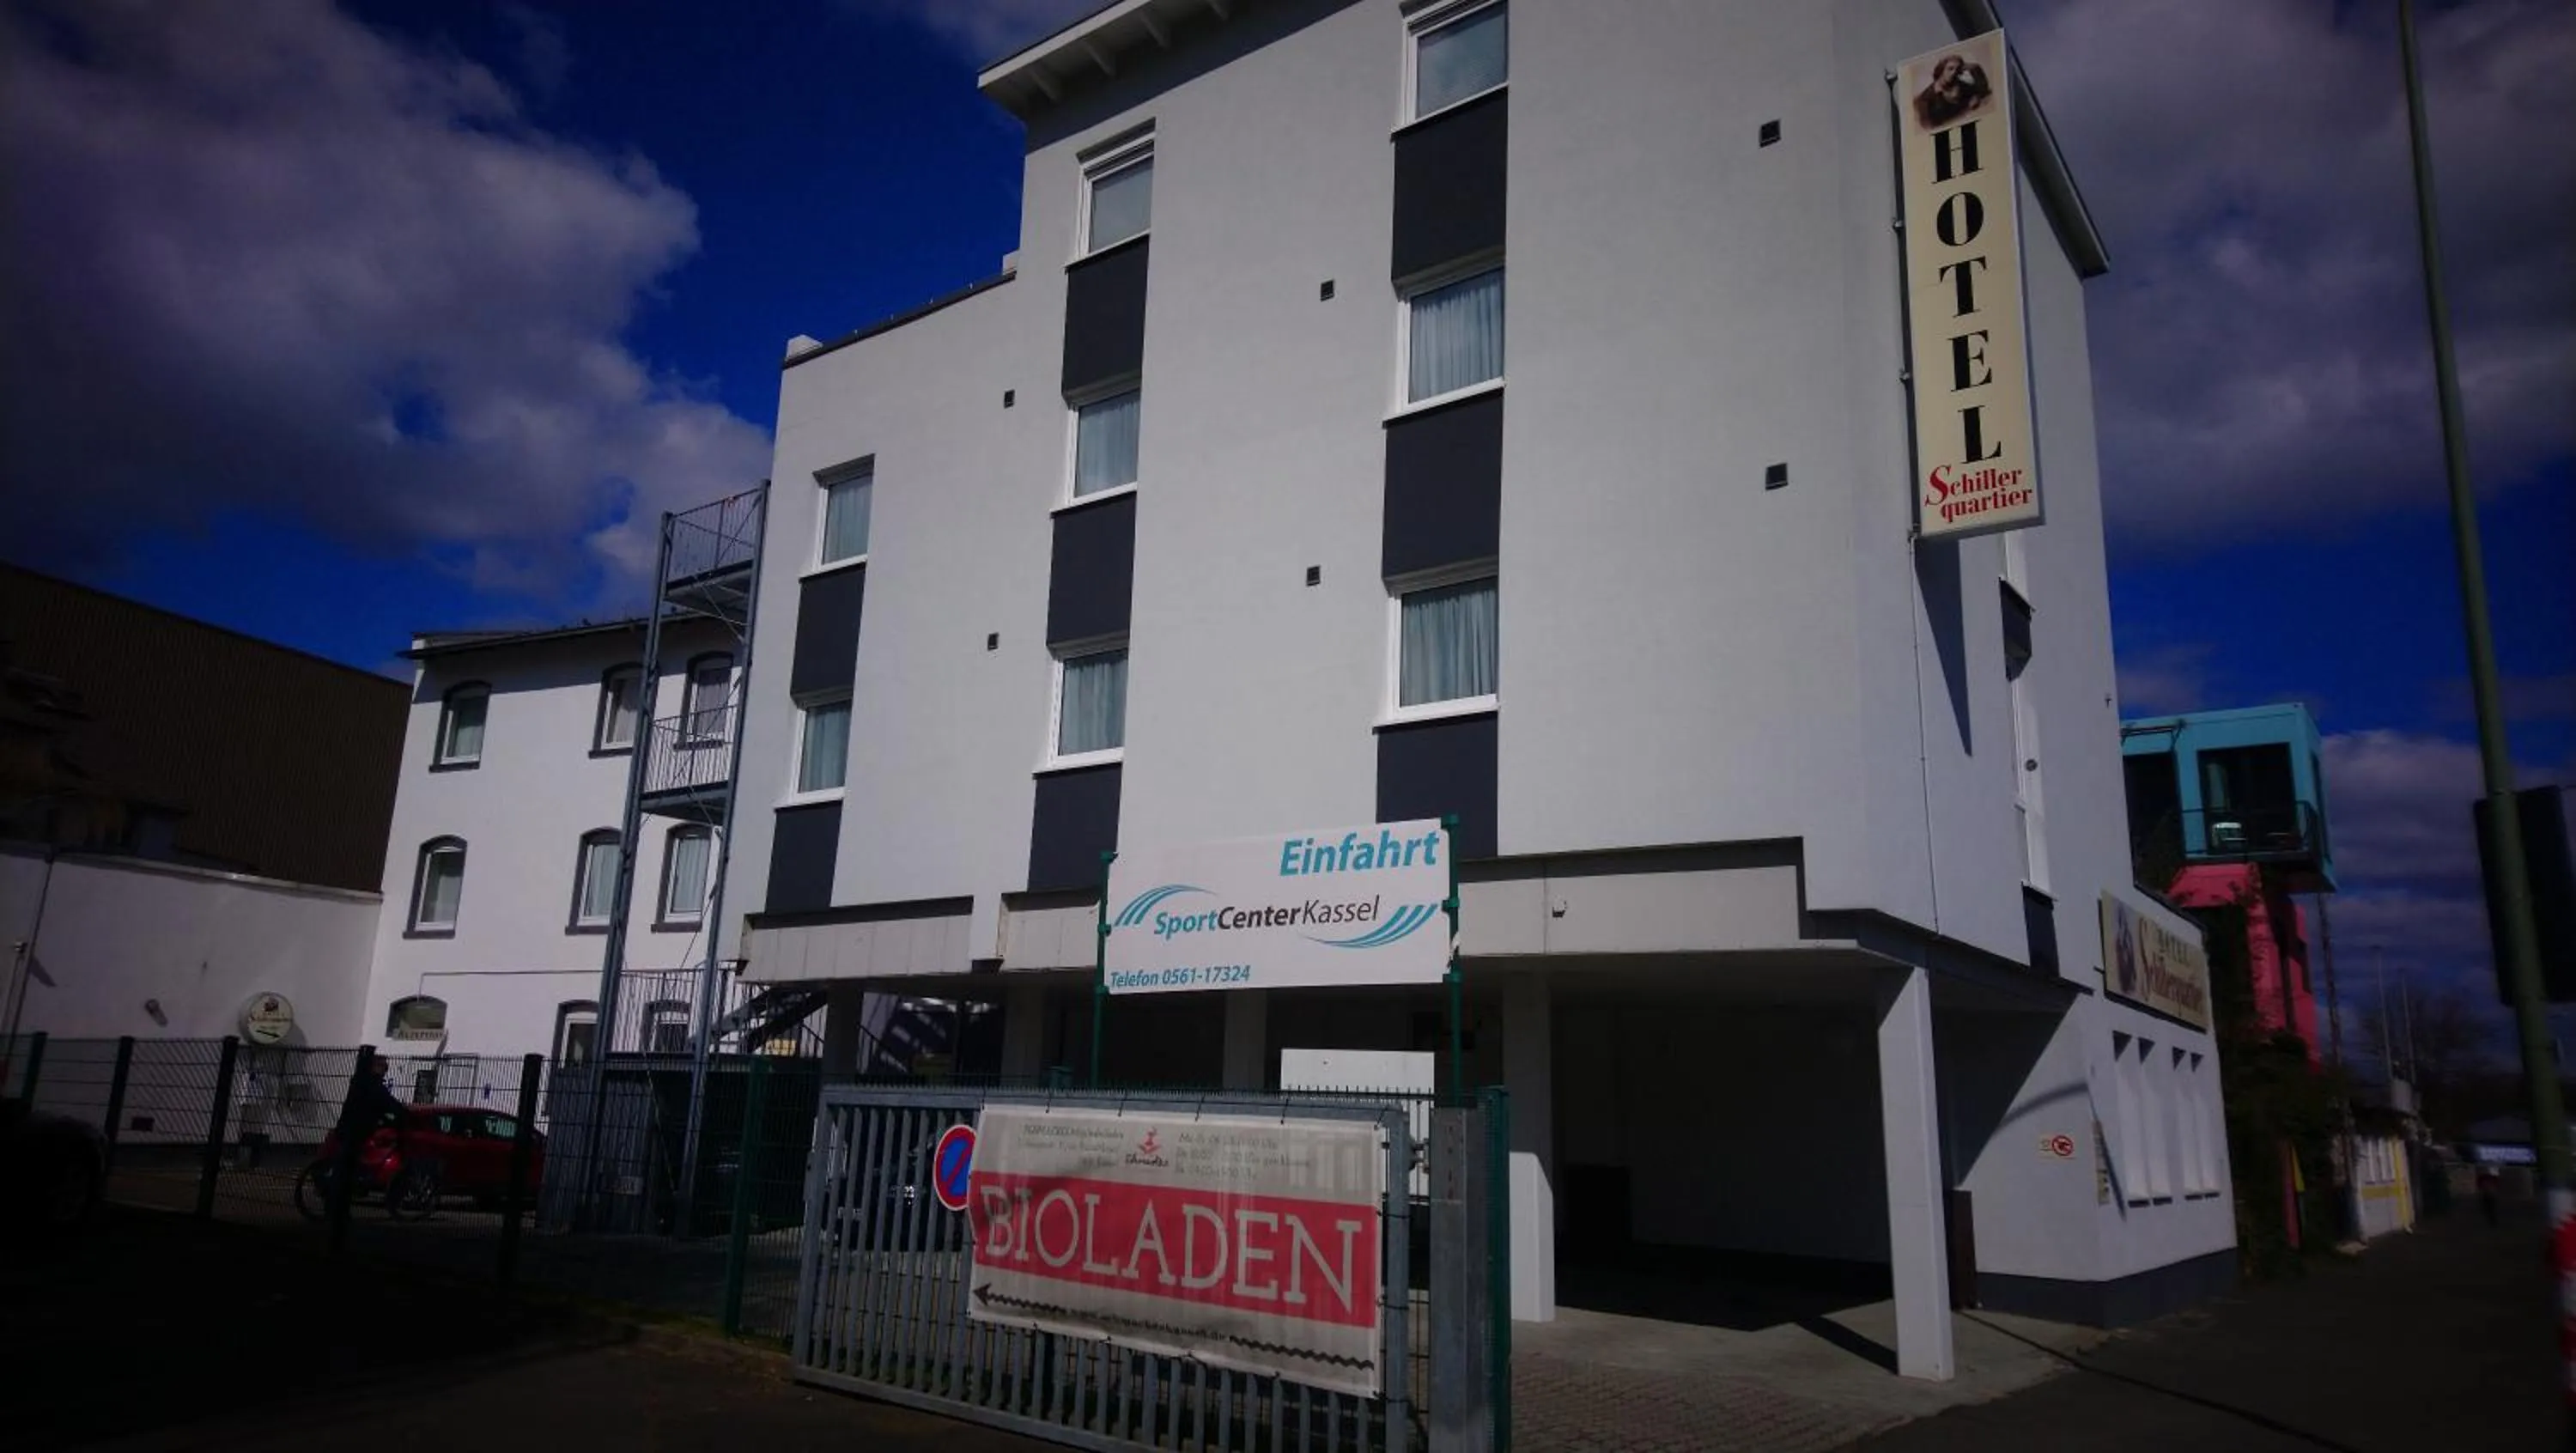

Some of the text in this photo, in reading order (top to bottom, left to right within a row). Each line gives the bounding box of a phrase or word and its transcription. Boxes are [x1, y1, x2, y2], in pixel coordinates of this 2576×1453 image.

[1929, 119, 2002, 465] HOTEL
[1924, 465, 2023, 507] Schiller
[1940, 487, 2033, 523] quartier
[1279, 830, 1440, 877] Einfahrt
[1152, 894, 1382, 940] SportCenterKassel
[1109, 964, 1251, 988] Telefon 0561-17324
[979, 1184, 1364, 1314] BIOLADEN
